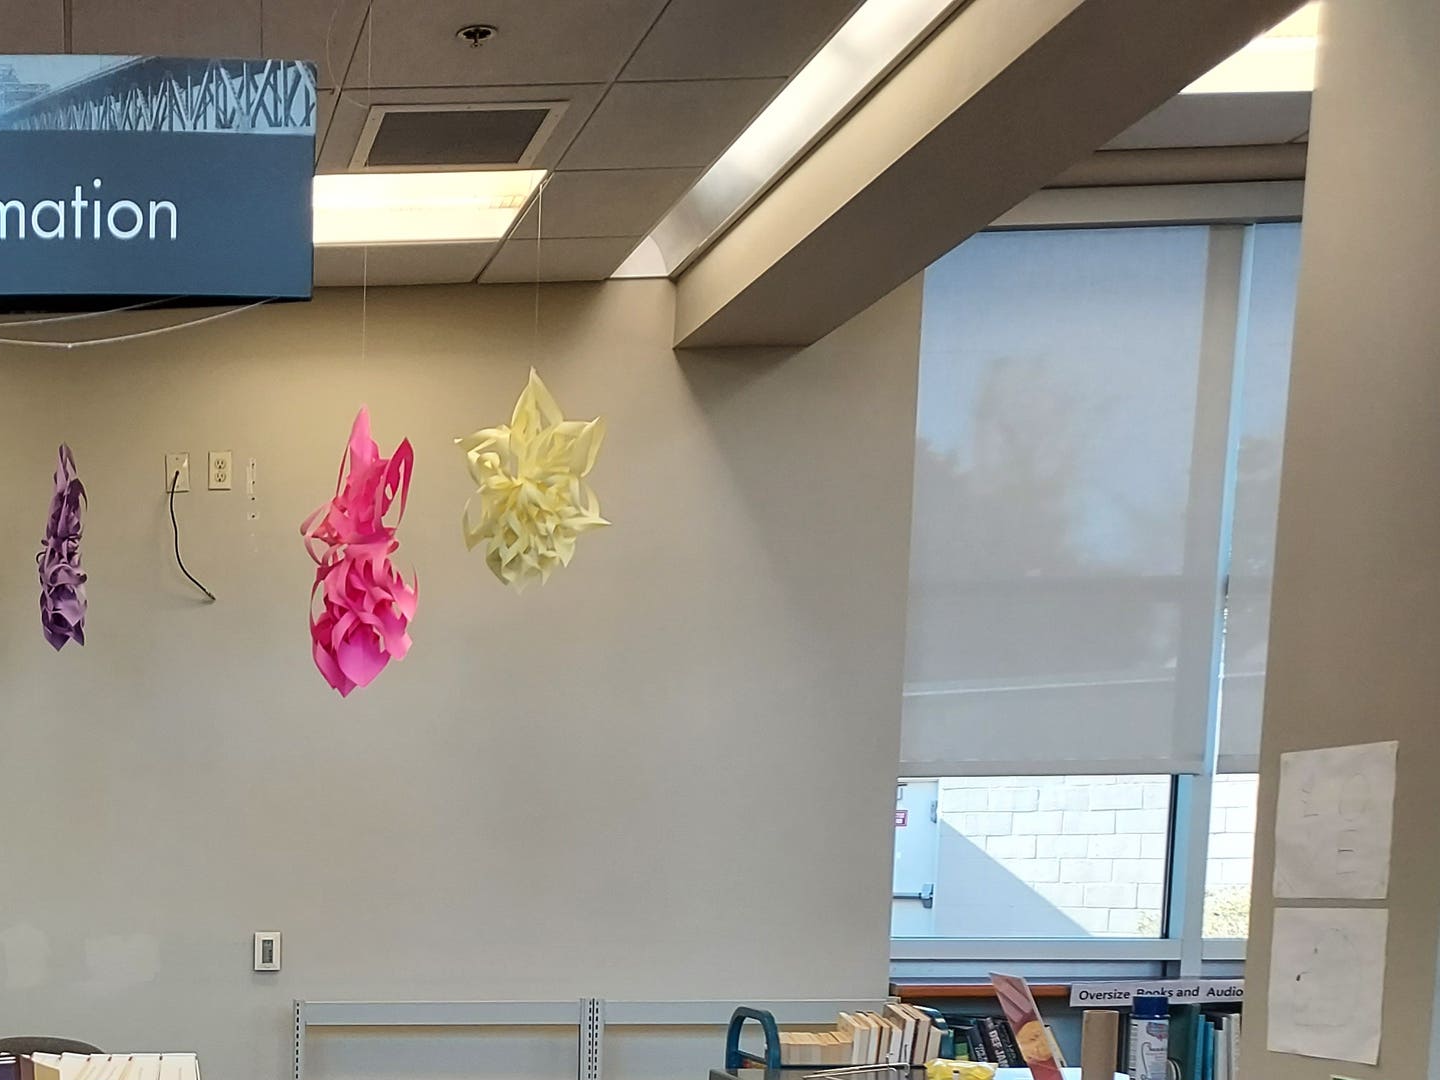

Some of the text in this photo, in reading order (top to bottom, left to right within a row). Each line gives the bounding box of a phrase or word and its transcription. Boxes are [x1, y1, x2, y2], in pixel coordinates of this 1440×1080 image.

[1079, 988, 1131, 1000] Oversize
[1176, 986, 1200, 997] and
[1206, 986, 1243, 997] Audio
